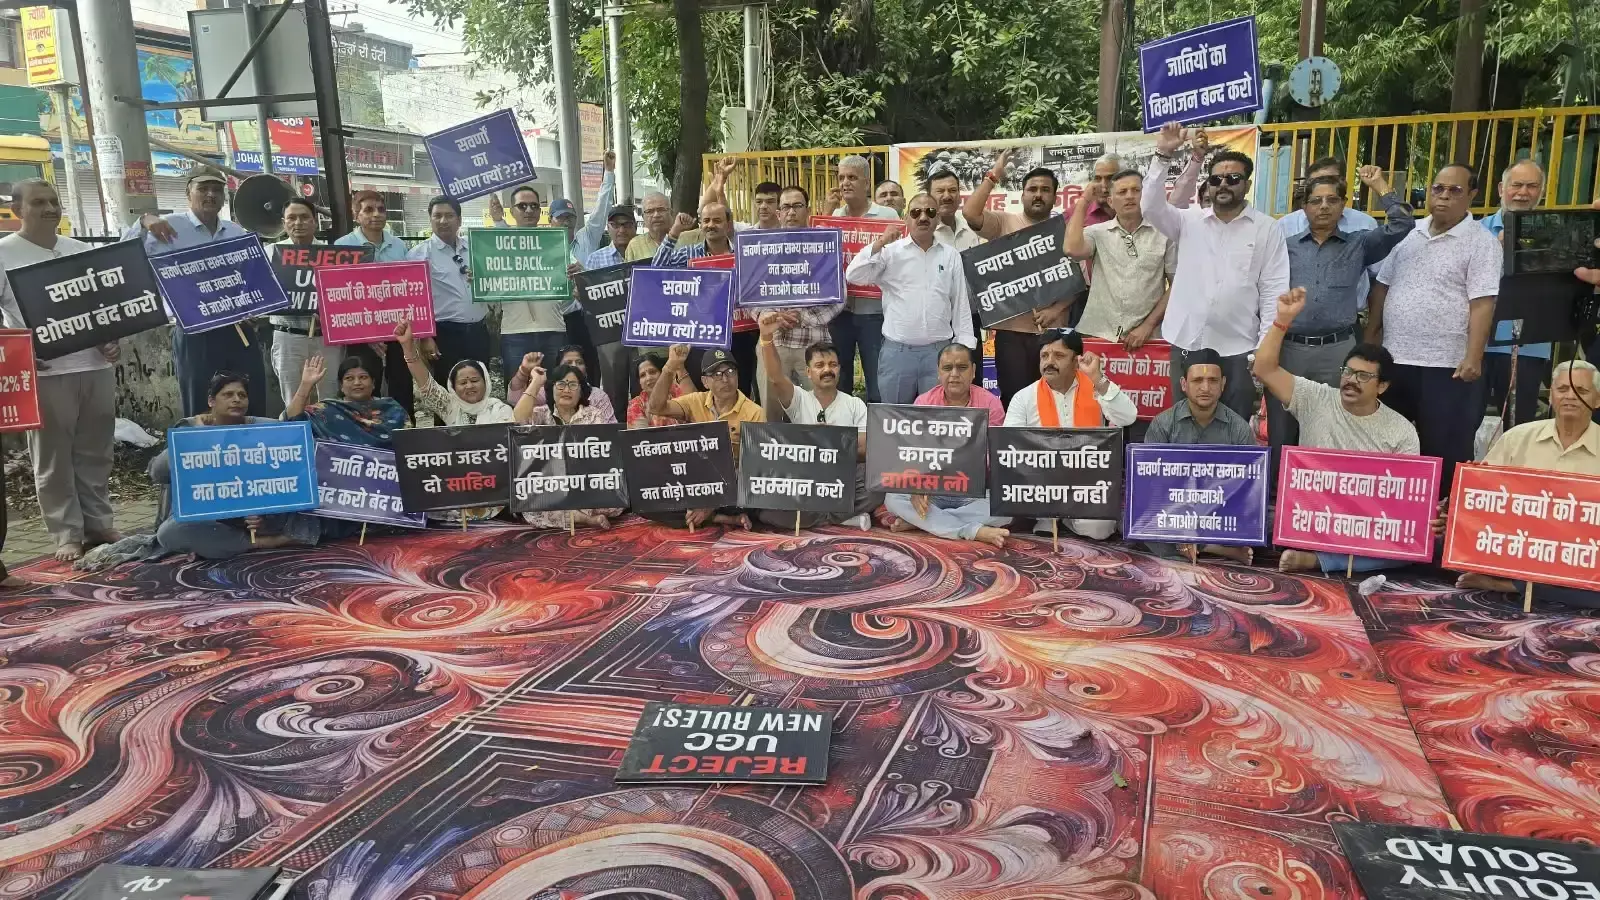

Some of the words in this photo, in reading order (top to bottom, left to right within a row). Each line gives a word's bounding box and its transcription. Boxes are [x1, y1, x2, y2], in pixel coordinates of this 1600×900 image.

[1166, 43, 1208, 76] जातियों
[1209, 44, 1227, 66] का
[1149, 90, 1199, 118] विभाजन
[1199, 83, 1225, 106] बन्द
[1226, 71, 1252, 101] करो
[455, 125, 490, 152] सवर्णों
[289, 157, 316, 167] STORE
[471, 152, 488, 166] का
[449, 177, 481, 195] शोषण
[481, 164, 503, 184] क्यों
[503, 161, 524, 178] ???
[496, 236, 516, 250] UGC
[519, 236, 542, 250] BILL
[742, 241, 761, 256] सवर्ण
[762, 243, 783, 255] समाज
[784, 243, 801, 254] सभ्य
[802, 242, 824, 254] समाज
[825, 241, 835, 253] !!!
[180, 260, 208, 275] समाज
[248, 246, 261, 258] !!!
[282, 248, 365, 266] REJECT
[486, 256, 513, 270] ROLL
[515, 256, 553, 270] BACK...
[974, 250, 1014, 275] न्याय
[1013, 234, 1056, 260] चाहिए
[768, 264, 779, 275] मत
[781, 260, 811, 276] उकसाओ,
[45, 268, 98, 302] सवर्ण
[97, 266, 125, 287] का
[197, 280, 214, 293] मत
[353, 283, 365, 300] की
[393, 279, 408, 297] क्यों
[409, 281, 424, 297] ???
[480, 277, 563, 291] IMMEDIATELY...
[585, 279, 624, 300] काला
[662, 276, 701, 296] सवर्णों
[760, 281, 767, 296] हो
[768, 281, 790, 295] जाओगे
[792, 280, 808, 294] बर्बाद
[810, 282, 820, 294] !!!
[977, 272, 1042, 311] तुष्टिकरण
[1041, 256, 1073, 282] नहीं
[198, 300, 210, 316] हो
[208, 295, 235, 313] जाओगे
[232, 291, 254, 307] बर्बाद
[251, 290, 264, 302] !!!
[671, 302, 688, 317] का
[36, 312, 93, 344] शोषण
[92, 304, 121, 325] बंद
[120, 290, 158, 317] करो
[330, 311, 364, 328] आरक्षण
[364, 307, 372, 325] के
[416, 306, 427, 321] !!!
[596, 310, 626, 328] वाप
[632, 318, 670, 337] शोषण
[672, 321, 698, 338] क्यों
[699, 325, 722, 340] ???
[1109, 352, 1136, 375] बच्चों
[1136, 354, 1151, 375] को
[1141, 385, 1166, 407] बांटों
[883, 419, 922, 435] UGC
[928, 416, 973, 437] काले
[180, 444, 220, 469] सवर्णों
[222, 444, 240, 466] की
[268, 445, 302, 469] पुकार
[405, 452, 452, 469] हमका
[456, 449, 491, 464] जहर
[494, 444, 508, 462] दे
[521, 443, 564, 460] न्याय
[565, 437, 611, 458] चाहिए
[632, 441, 672, 457] रहिमन
[672, 440, 698, 453] धागा
[699, 435, 719, 451] प्रेम
[760, 438, 817, 462] योग्यता
[819, 448, 838, 464] का
[997, 445, 1057, 468] योग्यता
[1059, 445, 1112, 468] चाहिए
[330, 455, 364, 477] जाति
[671, 463, 686, 475] का
[898, 446, 954, 470] कानून
[1137, 458, 1161, 476] सवर्ण
[1162, 463, 1191, 477] समाज
[1192, 463, 1214, 478] सभ्य
[1216, 464, 1246, 478] समाज
[1248, 464, 1260, 479] !!!
[192, 484, 214, 501] मत
[216, 476, 243, 499] करो
[246, 476, 298, 496] अत्याचार
[422, 475, 442, 493] दो
[446, 472, 496, 491] साहिब
[514, 472, 586, 500] तुष्टिकरण
[588, 468, 623, 490] नहीं
[640, 487, 660, 500] मत
[661, 482, 684, 501] तोड़ो
[686, 482, 724, 496] चटकाय
[750, 476, 814, 496] सम्मान
[816, 479, 844, 498] करो
[881, 469, 940, 489] वापिस
[943, 471, 969, 492] लो
[1290, 468, 1338, 494] आरक्षण
[1339, 472, 1376, 497] हटाना
[1378, 469, 1406, 499] होगा
[1408, 478, 1426, 502] !!!
[338, 487, 368, 508] करो
[369, 490, 390, 511] बंद
[1002, 485, 1069, 503] आरक्षण
[1071, 480, 1112, 504] नहीं
[1169, 488, 1184, 502] मत
[1186, 486, 1226, 507] उकसाओ,
[1464, 485, 1509, 514] हमारे
[1512, 490, 1553, 519] बच्चों
[1553, 493, 1577, 522] को
[1157, 509, 1168, 528] हो
[1168, 511, 1198, 529] जाओगे
[1199, 512, 1222, 530] बर्बाद
[1224, 516, 1236, 531] !!!
[1292, 502, 1313, 532] देश
[1314, 506, 1332, 534] को
[1333, 513, 1372, 538] बचाना
[1374, 511, 1402, 542] होगा
[1404, 520, 1416, 543] !!
[1476, 525, 1505, 555] भेद
[1508, 529, 1528, 558] में
[1528, 538, 1558, 563] मत
[652, 708, 752, 731] RULES!
[759, 713, 823, 732] NEW
[684, 733, 778, 752] UGC
[640, 754, 807, 774] REJECT
[1386, 838, 1579, 875] SQUAD
